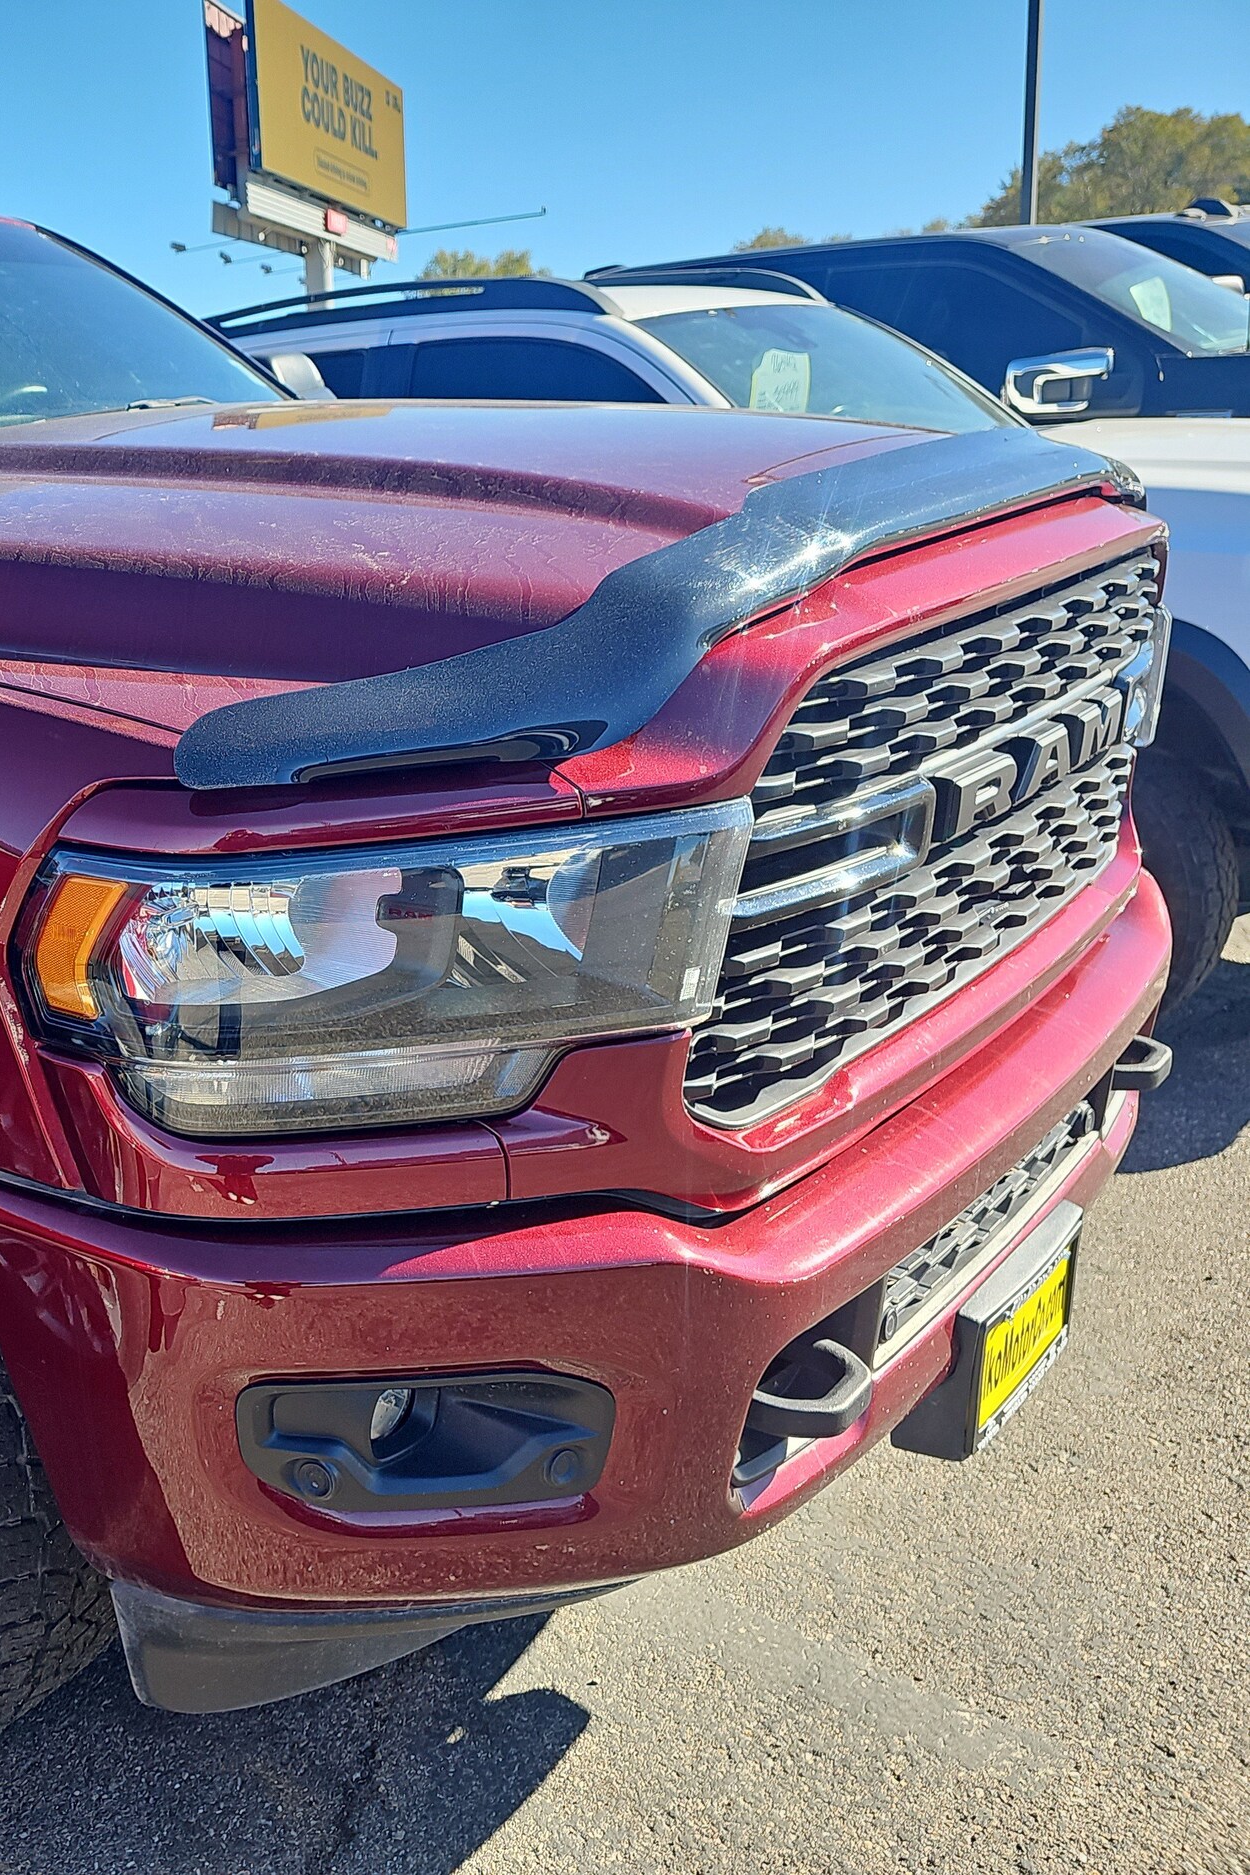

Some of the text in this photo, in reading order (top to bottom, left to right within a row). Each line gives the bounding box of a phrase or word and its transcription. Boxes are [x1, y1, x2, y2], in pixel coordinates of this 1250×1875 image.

[300, 45, 339, 99] YOUR
[342, 72, 372, 121] BUZZ
[301, 85, 347, 141] COULD
[350, 116, 378, 160] KILL.
[930, 686, 1124, 843] RAM
